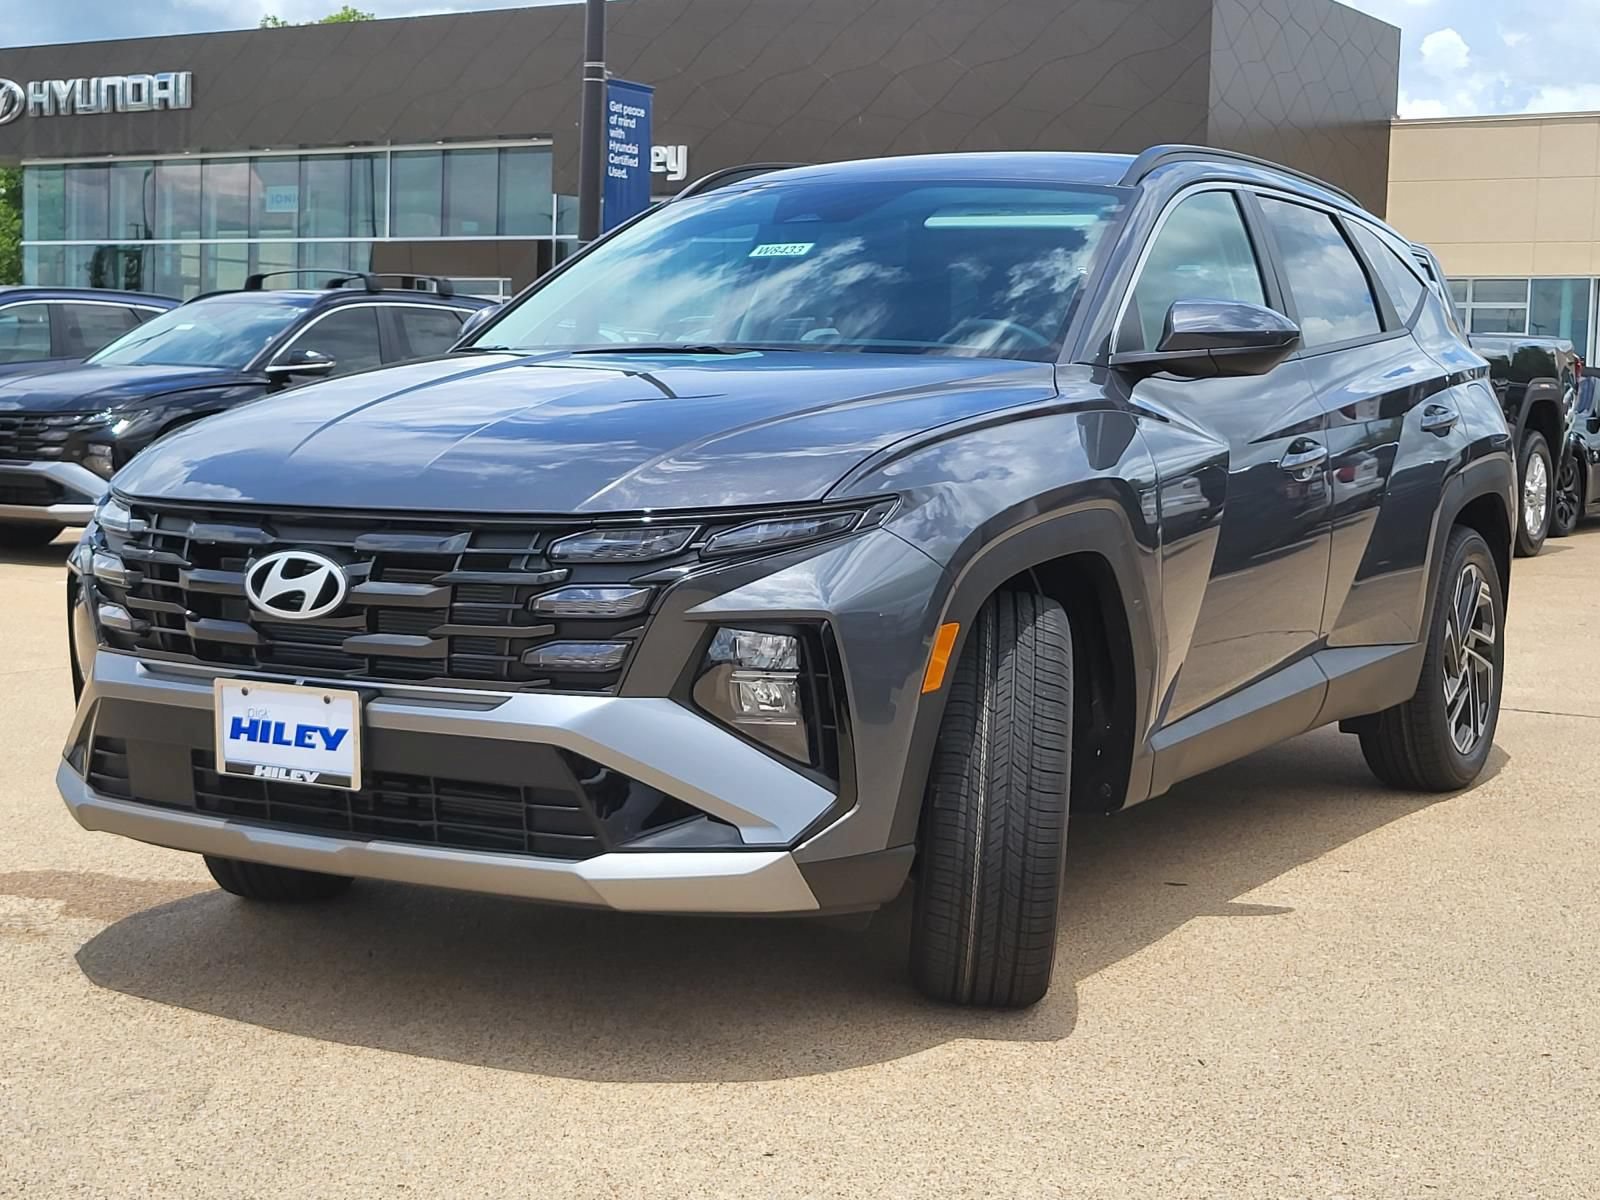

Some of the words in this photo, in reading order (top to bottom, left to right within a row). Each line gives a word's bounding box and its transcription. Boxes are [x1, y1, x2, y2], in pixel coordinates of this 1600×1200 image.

[27, 71, 193, 118] HYUNDAI
[609, 101, 622, 112] Get
[623, 105, 645, 117] peace
[609, 114, 618, 125] of
[618, 116, 637, 128] mind
[609, 127, 625, 139] with
[609, 140, 639, 154] Hyundai
[608, 153, 639, 167] Certified
[650, 145, 688, 181] ey
[757, 245, 805, 256] W8433
[229, 716, 349, 751] HILEY
[253, 764, 321, 783] HILEY
